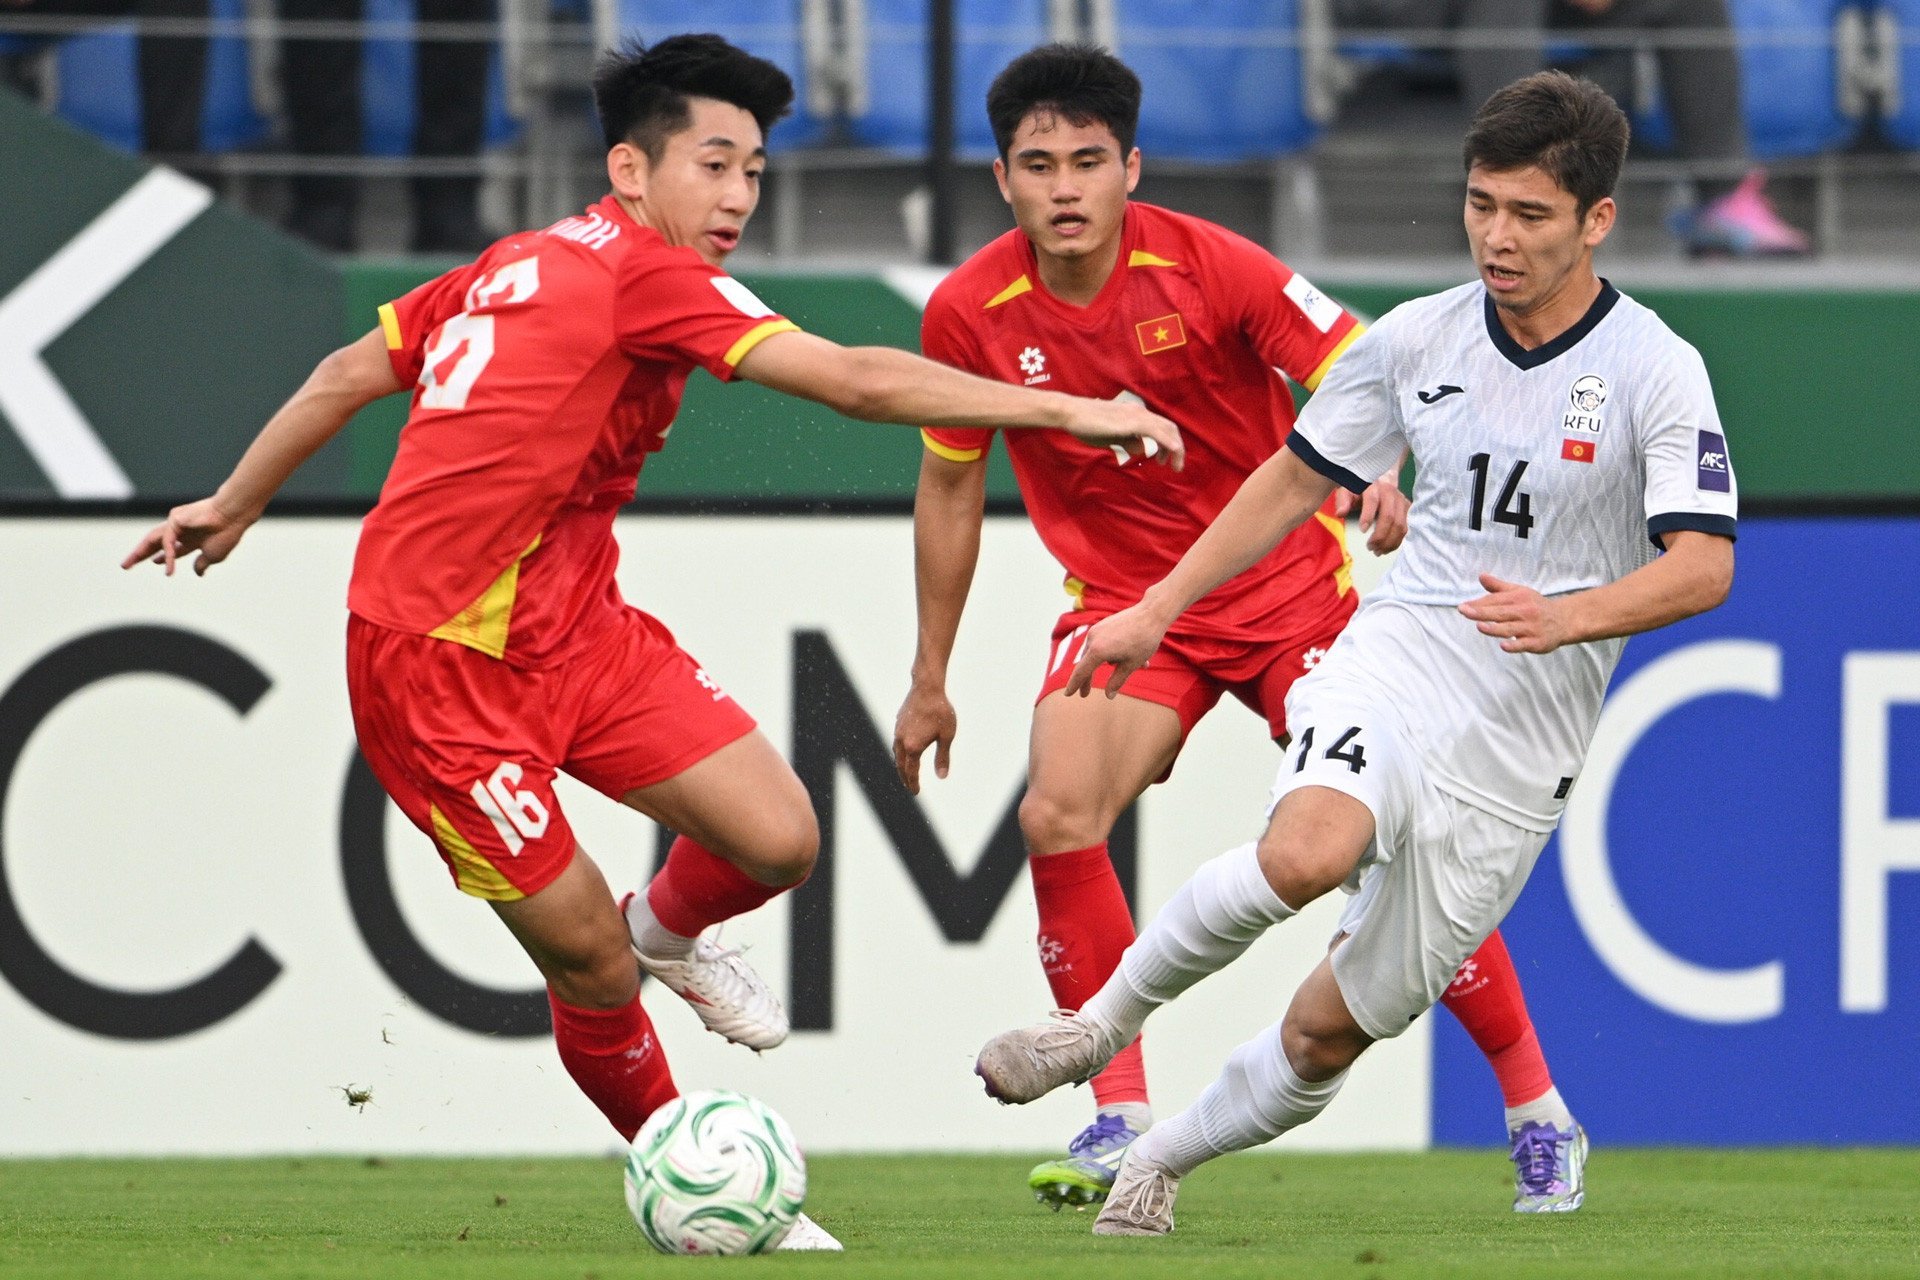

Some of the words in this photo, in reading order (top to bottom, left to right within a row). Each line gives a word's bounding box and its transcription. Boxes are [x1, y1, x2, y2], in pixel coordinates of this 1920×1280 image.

[1564, 414, 1601, 432] KFU
[1699, 451, 1726, 469] AFC
[1466, 451, 1534, 539] 14
[1293, 726, 1367, 775] 14
[469, 761, 549, 858] 16
